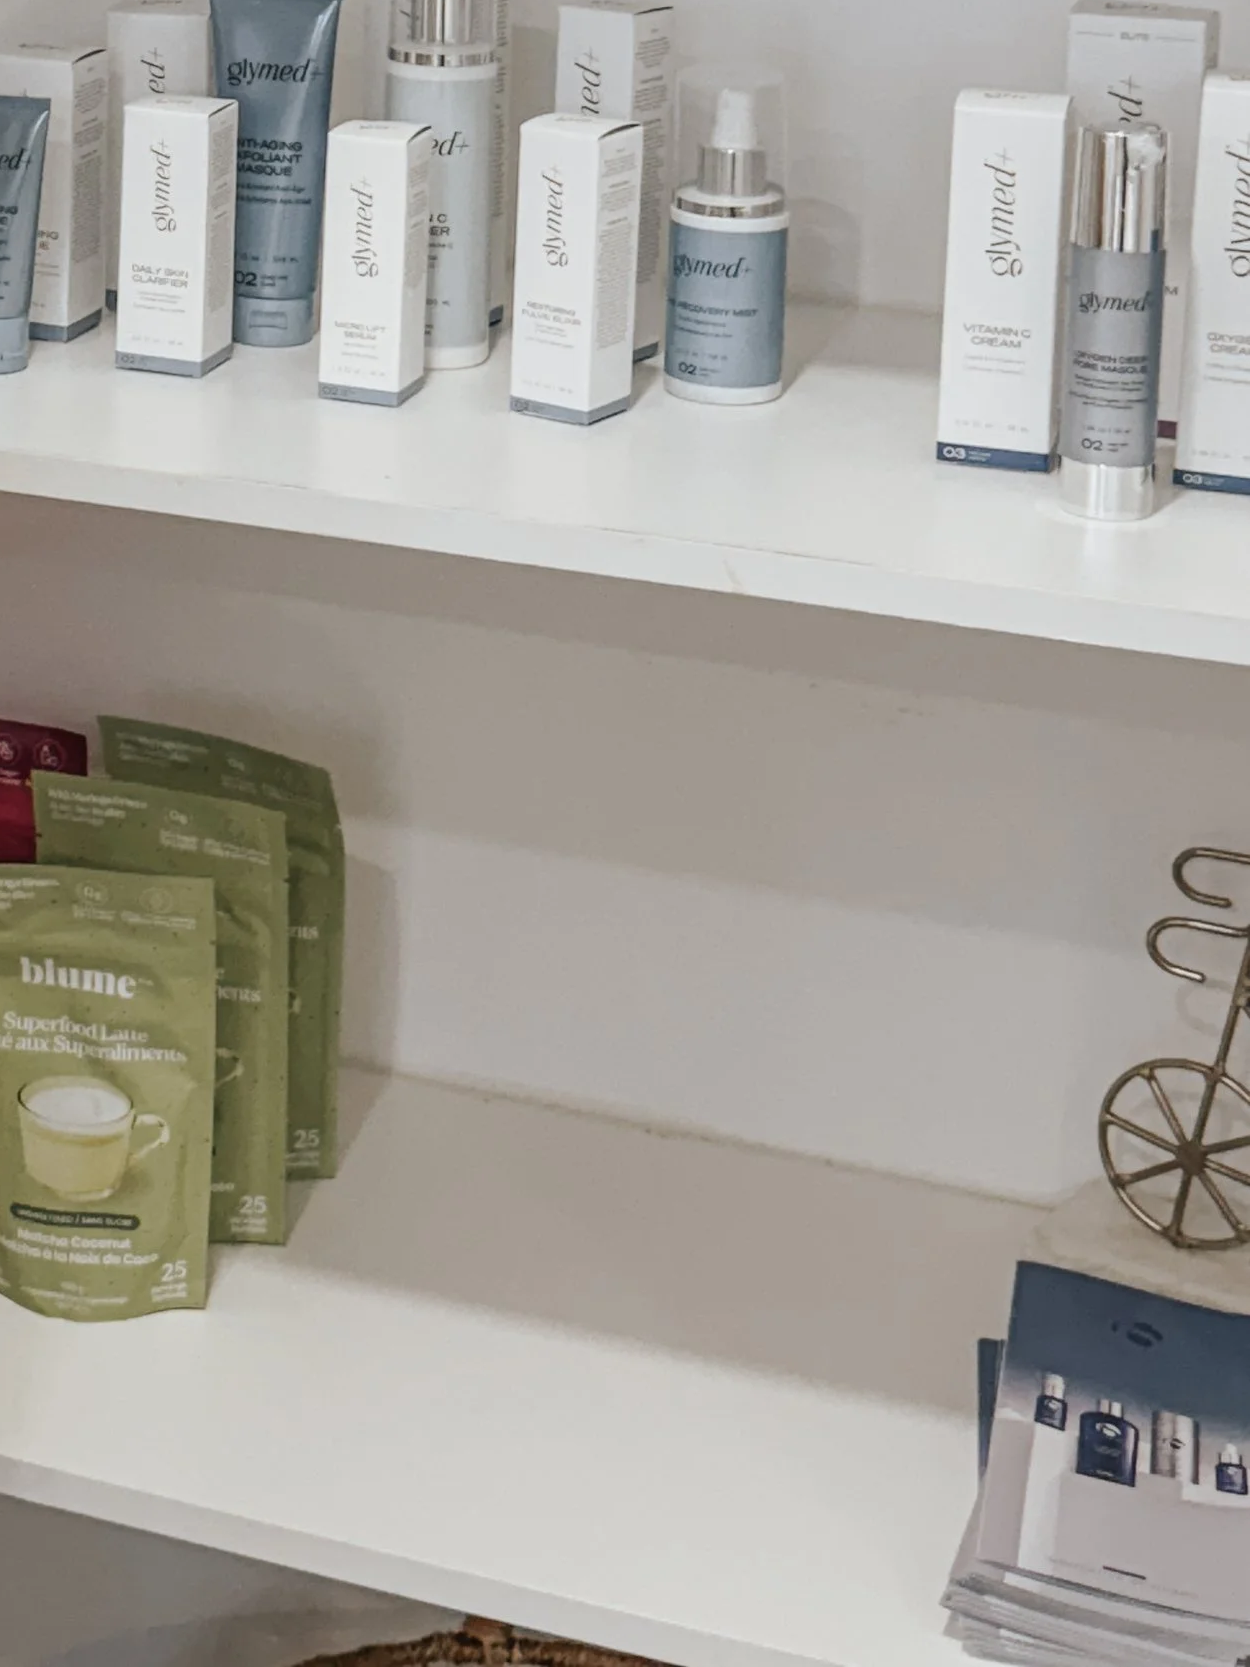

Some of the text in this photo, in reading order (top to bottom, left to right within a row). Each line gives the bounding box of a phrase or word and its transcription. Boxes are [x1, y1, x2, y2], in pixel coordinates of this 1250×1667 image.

[131, 263, 161, 275] DAILY
[963, 322, 1019, 338] VITAMIN
[970, 335, 1023, 349] CREAM
[1210, 343, 1250, 356] CREA
[678, 361, 698, 376] 02
[1100, 364, 1149, 375] MASQUE
[943, 445, 967, 460] 03
[1081, 437, 1104, 452] 02
[1182, 473, 1203, 485] 03
[20, 955, 137, 1000] blume
[3, 1011, 149, 1043] Superfood Latte
[14, 1034, 49, 1052] aux
[52, 1035, 188, 1063] Superaliments
[293, 1128, 320, 1149] 25
[238, 1195, 268, 1215] 25
[17, 1227, 132, 1249] Matcha Coconut
[53, 1249, 68, 1261] la
[69, 1250, 100, 1264] Noix
[102, 1253, 121, 1265] de
[123, 1252, 160, 1266] Coco
[161, 1260, 188, 1282] 25
